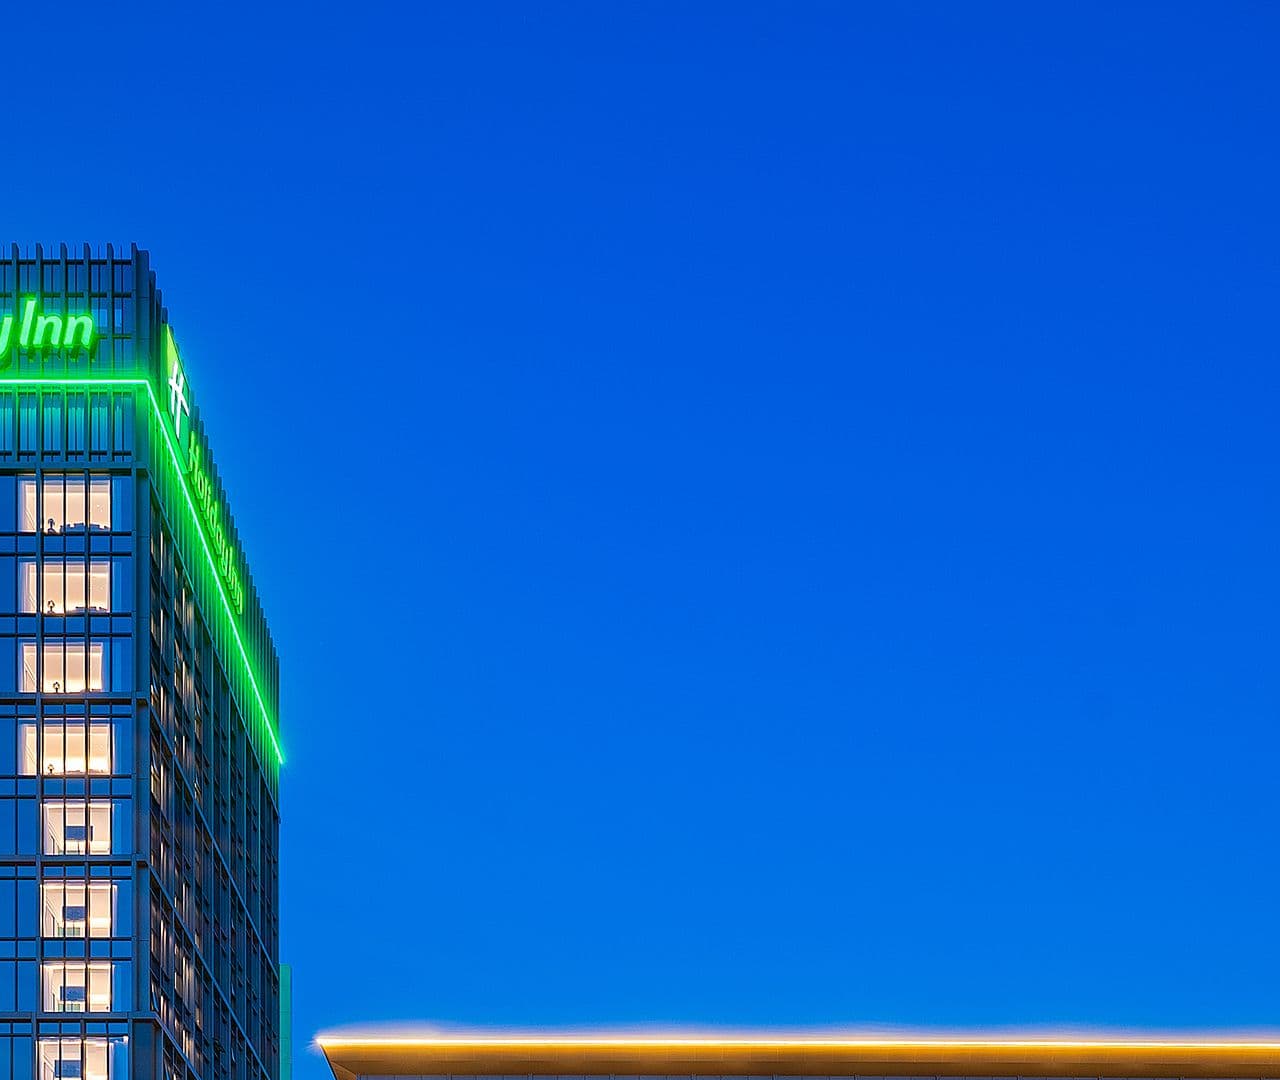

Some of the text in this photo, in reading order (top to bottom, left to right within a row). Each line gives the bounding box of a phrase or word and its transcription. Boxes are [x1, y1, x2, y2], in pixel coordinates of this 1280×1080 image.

[19, 298, 95, 348] Inn
[189, 430, 229, 577] Holiday
[228, 545, 243, 615] Inn
